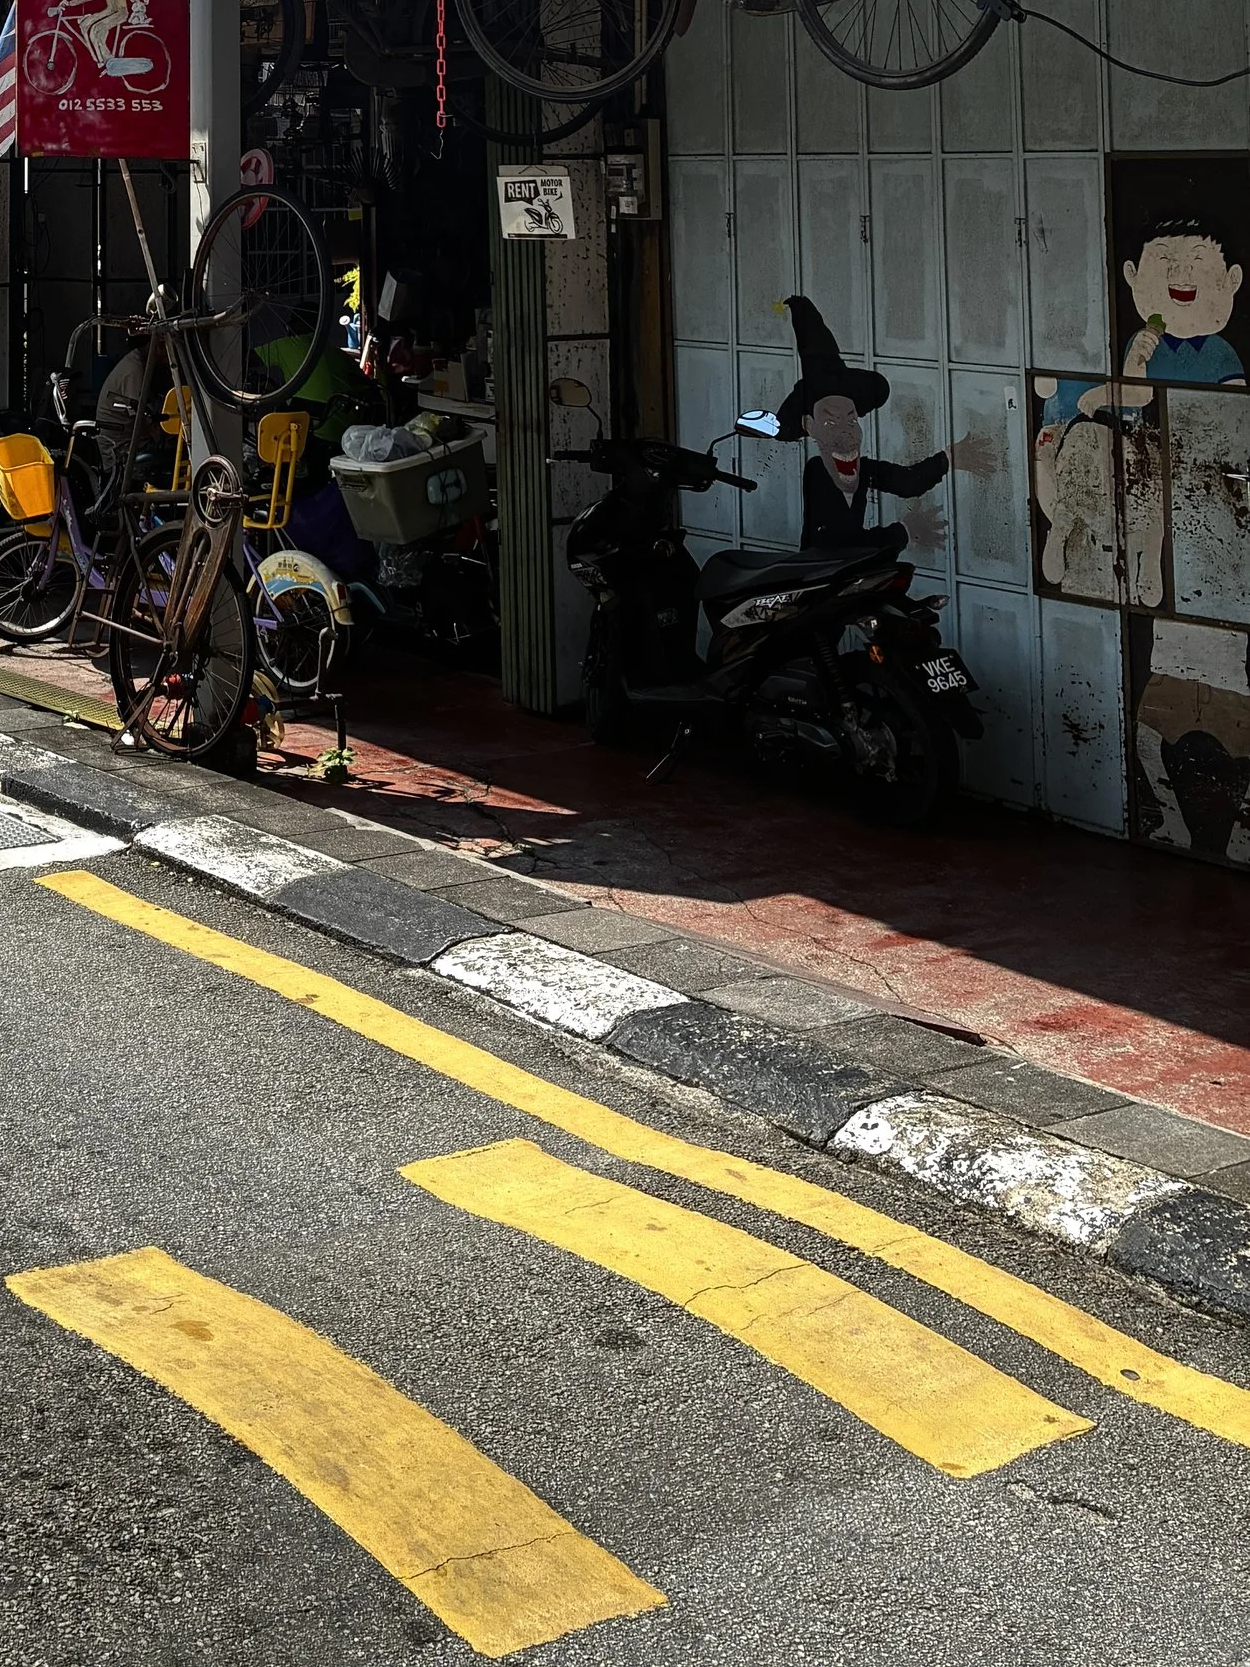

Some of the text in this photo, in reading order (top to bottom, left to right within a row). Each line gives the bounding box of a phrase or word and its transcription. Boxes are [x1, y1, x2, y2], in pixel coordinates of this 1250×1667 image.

[58, 98, 163, 112] 012 5533 553
[507, 179, 563, 199] RENT MOTOR
[543, 187, 558, 196] BIKE
[922, 656, 955, 677] VKE
[927, 670, 967, 693] 9645
